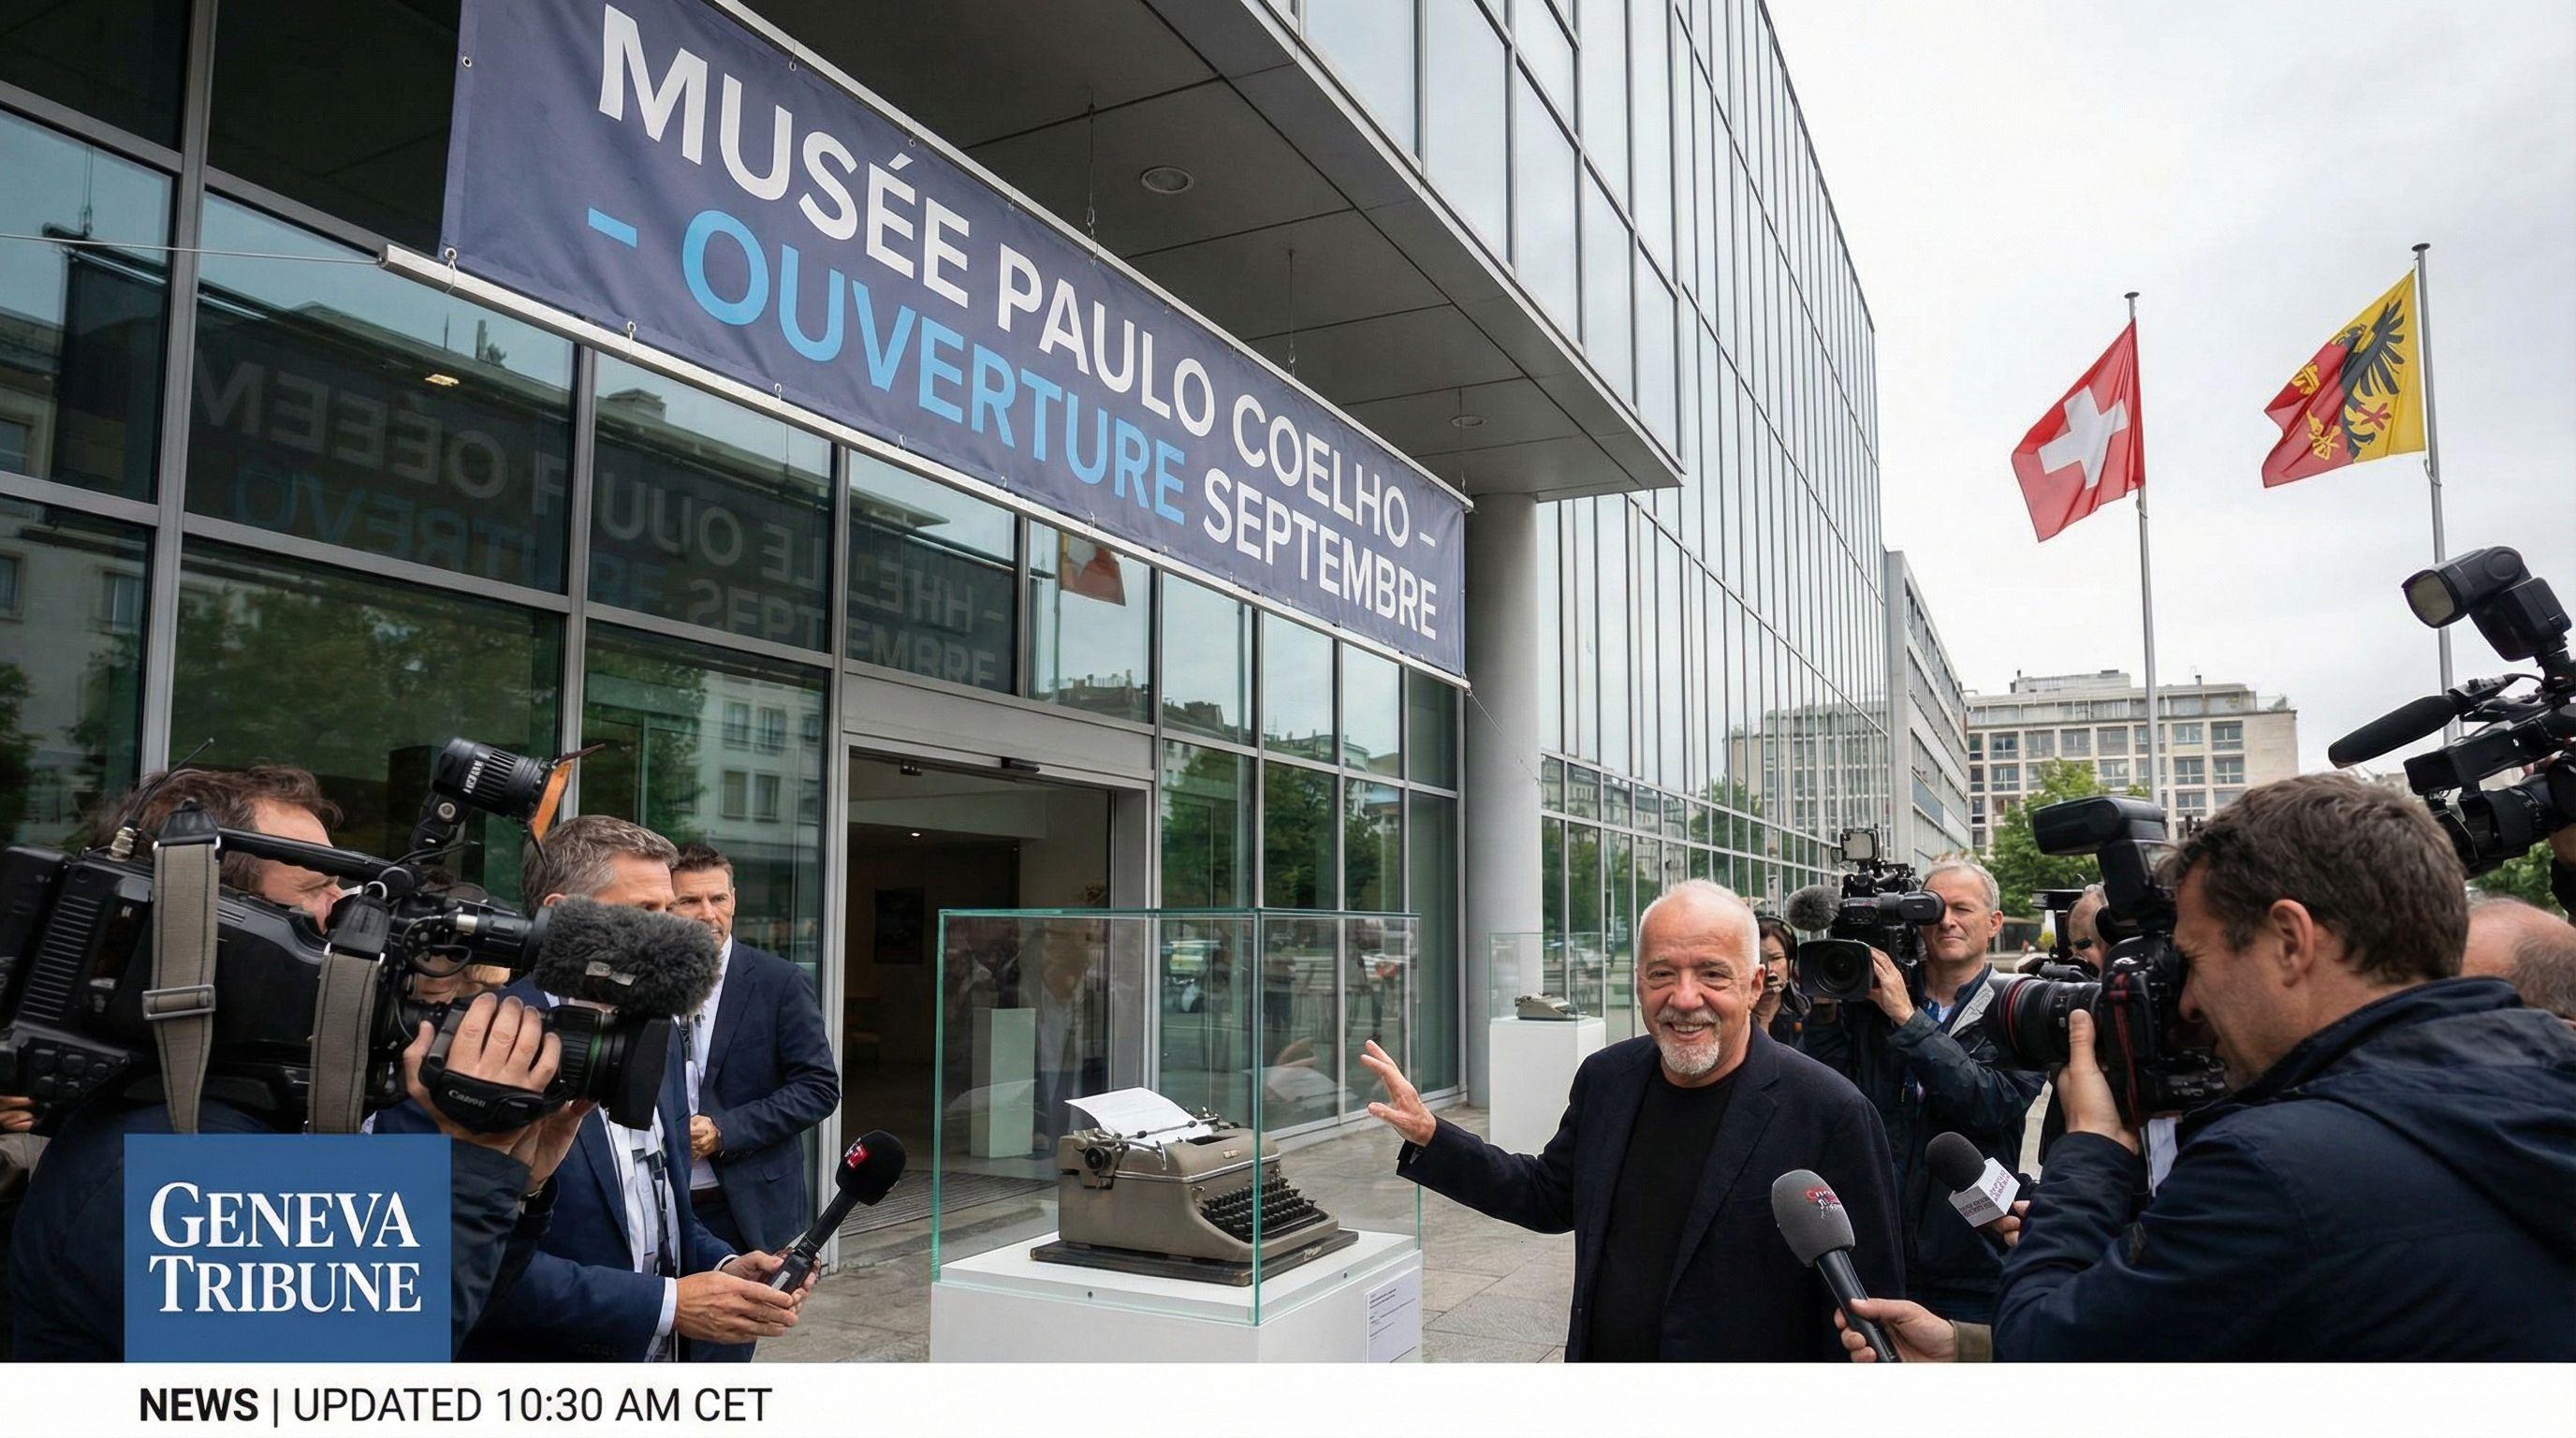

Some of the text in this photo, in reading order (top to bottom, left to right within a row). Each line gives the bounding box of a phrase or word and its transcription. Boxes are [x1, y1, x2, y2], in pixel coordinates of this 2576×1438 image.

[598, 3, 970, 309] MUSÉE
[997, 242, 1216, 437] PAULO
[1232, 394, 1410, 549] COELHO
[681, 211, 1186, 525] OUVERTURE
[1203, 467, 1438, 641] SEPTEMBRE
